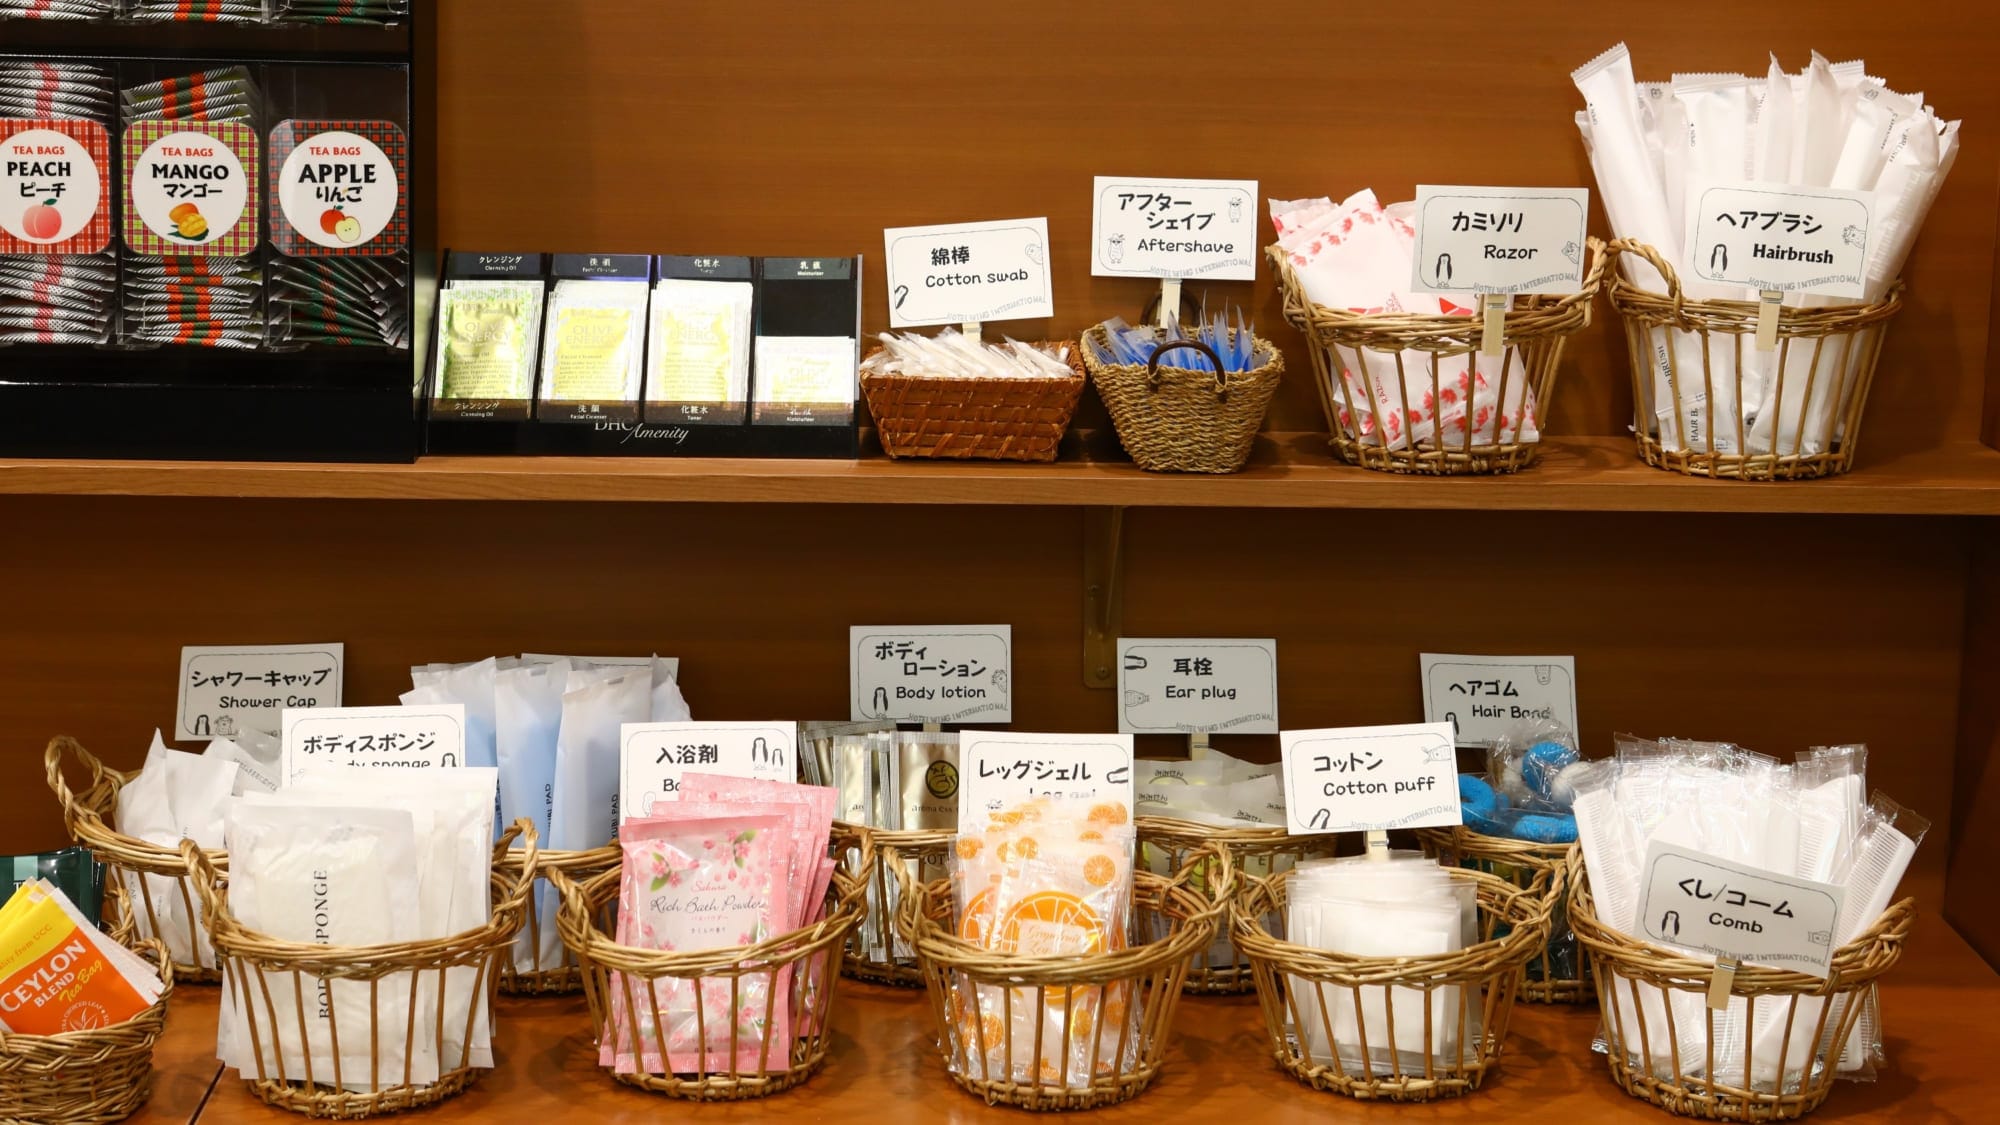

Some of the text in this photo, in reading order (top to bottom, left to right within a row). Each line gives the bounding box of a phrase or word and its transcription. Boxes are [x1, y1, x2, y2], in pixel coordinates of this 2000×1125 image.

[13, 146, 65, 155] TEA BAGS
[161, 147, 214, 157] TEA BAGS
[309, 147, 361, 156] TEA BAGS
[7, 161, 71, 177] PEACH
[152, 163, 229, 180] MANGO
[298, 164, 376, 183] APPLE
[20, 181, 66, 198] ピーチ
[163, 183, 223, 198] マンゴー
[316, 185, 362, 203] りんご
[1118, 193, 1192, 211] アフター
[1146, 211, 1216, 230] シェイブ
[1452, 211, 1524, 233] カミソリ
[1716, 211, 1823, 235] ヘアブラシ
[1137, 238, 1234, 253] Aftershave
[1484, 244, 1538, 260] Razor
[1753, 243, 1834, 264] Hairbrush
[479, 255, 523, 264] クレンジング
[931, 246, 970, 266] 綿棒
[925, 268, 1029, 288] Cotton swab
[620, 422, 689, 444] Amenity
[875, 641, 927, 660] ボディ
[904, 659, 986, 677] ローション
[1173, 657, 1213, 676] 耳栓
[191, 668, 332, 687] シャワーキャップ
[896, 686, 986, 700] Body lotion
[1165, 685, 1236, 700] Ear plug
[1449, 680, 1519, 697] ヘアゴム
[219, 695, 317, 708] Shower Cap
[1472, 704, 1505, 718] Hair
[303, 732, 436, 754] ボディスポンジ
[656, 744, 718, 764] 入浴剤
[1313, 752, 1383, 773] コットン
[979, 759, 1092, 780] レッグジェル
[1323, 776, 1435, 796] Cotton puff
[650, 895, 681, 913] Rich
[686, 896, 720, 913] Bath
[1678, 878, 1794, 918] くし/コーム
[33, 923, 52, 940] UCC
[1708, 912, 1763, 934] Comb
[0, 939, 88, 1013] CEYLON
[59, 959, 103, 1003] Tea Bag
[33, 971, 75, 1008] BLEND
